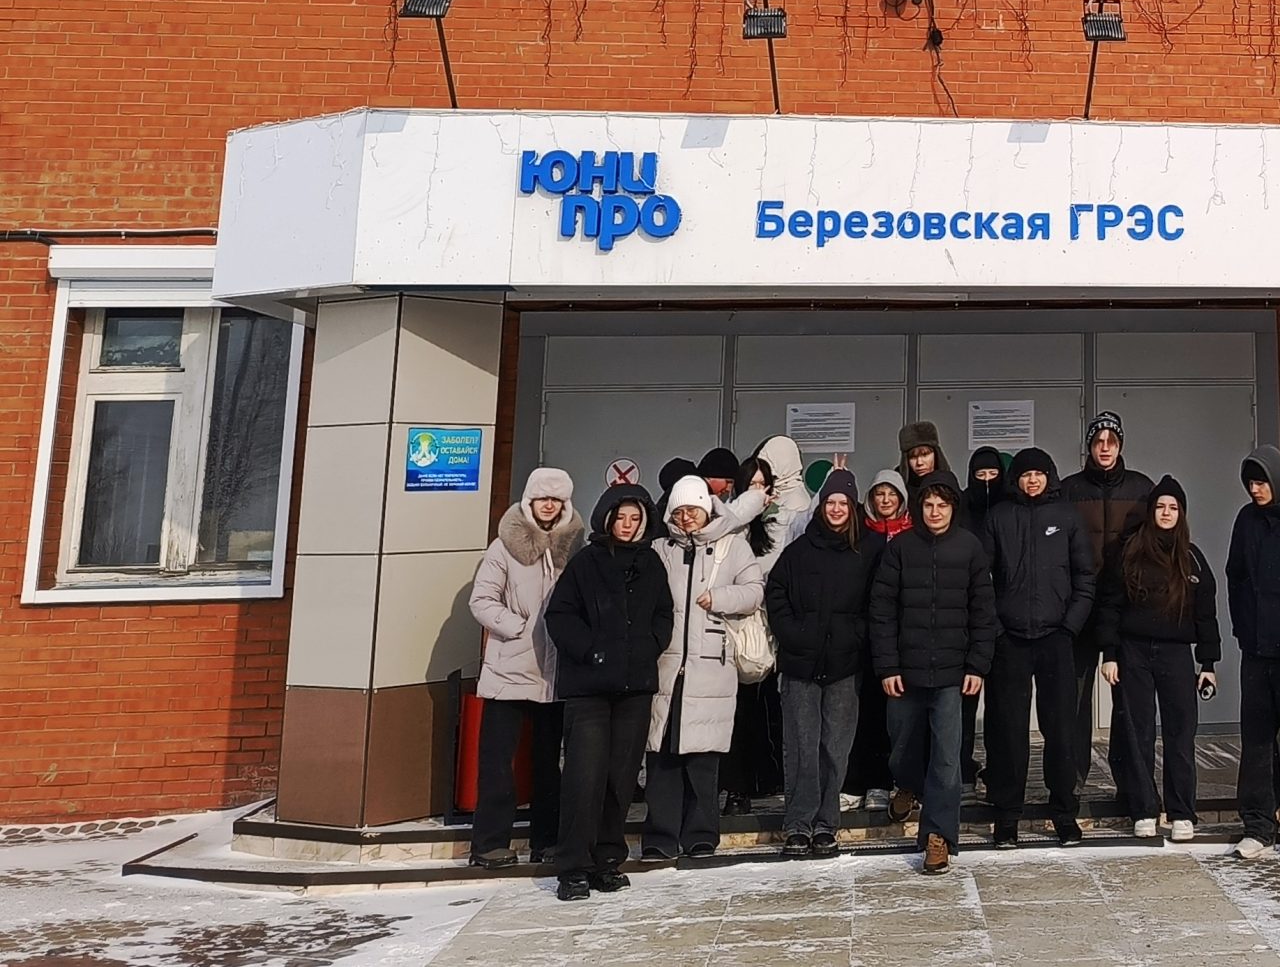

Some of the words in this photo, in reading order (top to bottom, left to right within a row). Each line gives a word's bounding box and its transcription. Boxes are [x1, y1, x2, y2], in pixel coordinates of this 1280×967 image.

[756, 201, 1050, 248] Березовская
[1070, 203, 1184, 240] ГРЭС
[441, 436, 479, 444] ЗАБОЛЕЛ?
[440, 446, 478, 454] ОСТАВАЙСЯ
[448, 456, 470, 464] ДОМА!
